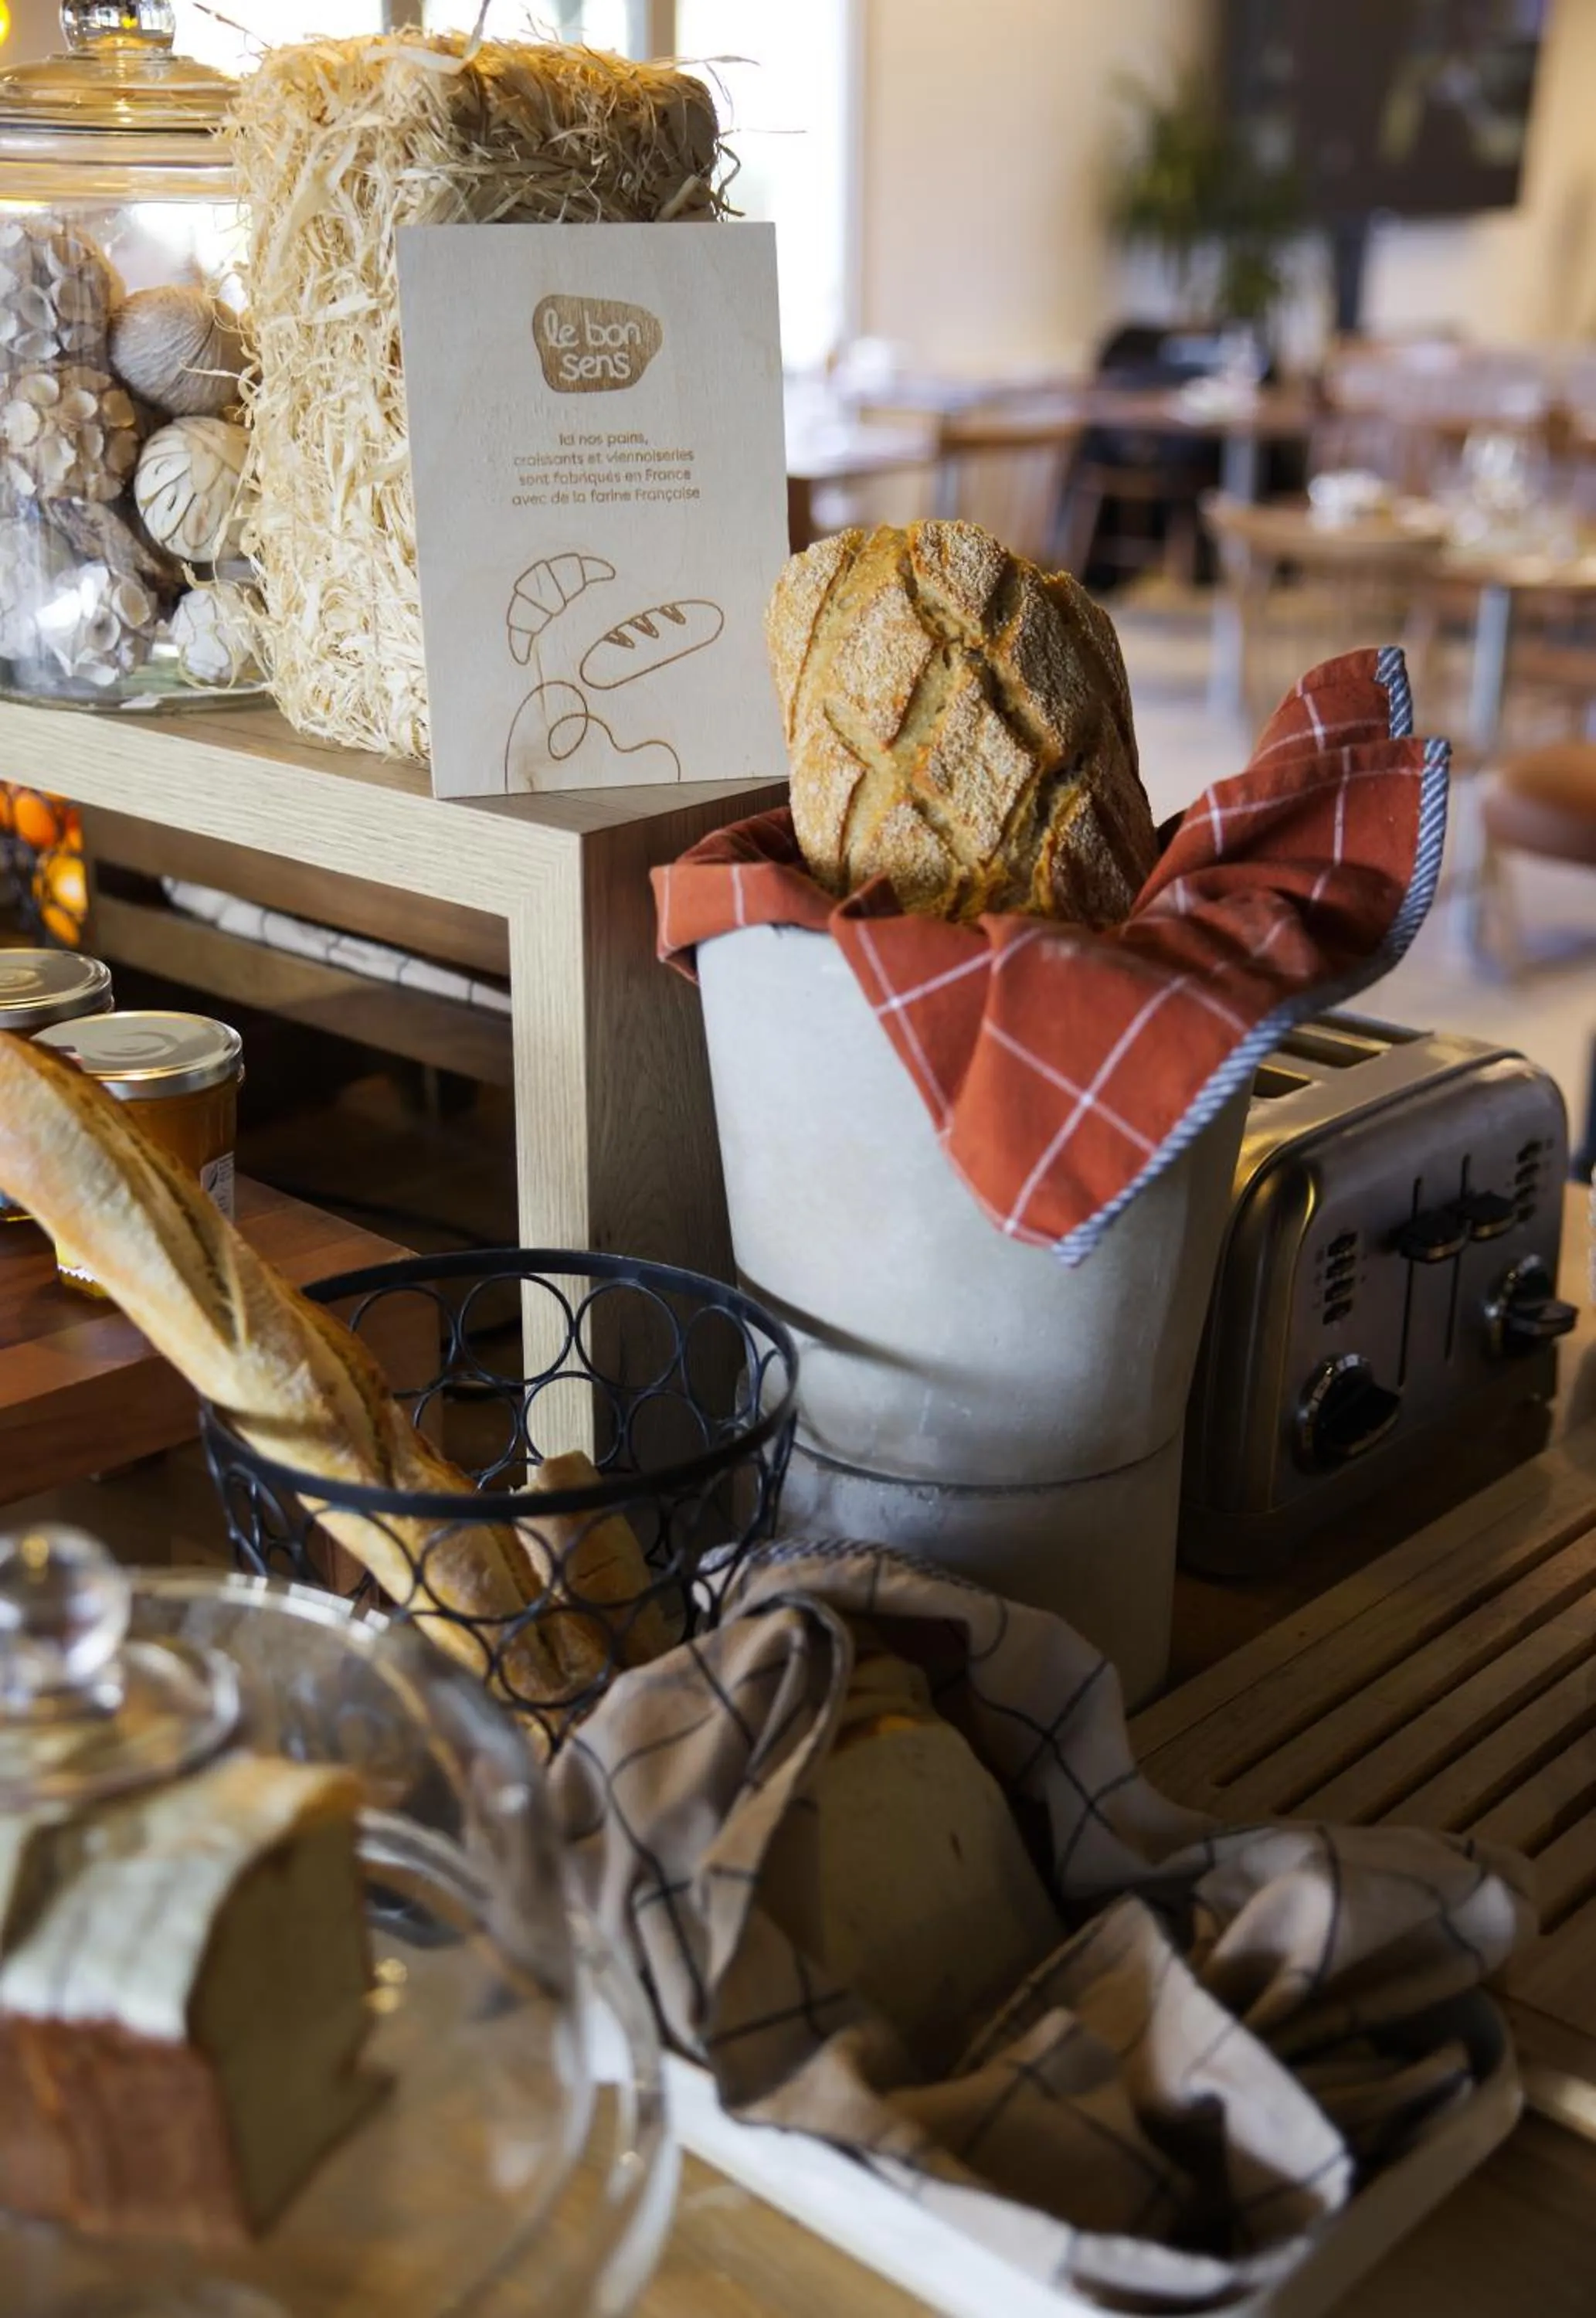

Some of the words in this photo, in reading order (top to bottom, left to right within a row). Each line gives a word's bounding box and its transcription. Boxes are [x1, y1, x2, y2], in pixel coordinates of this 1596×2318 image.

[543, 308, 579, 348] le
[583, 311, 640, 346] bon
[559, 352, 630, 380] sens
[559, 433, 574, 446] Ici
[579, 435, 602, 446] nos
[607, 433, 648, 447] pains,
[514, 453, 583, 466] croissants
[588, 452, 600, 464] et
[606, 448, 694, 463] viennoiseries
[519, 473, 548, 486] sont
[625, 472, 641, 482] en
[645, 468, 691, 481] France
[512, 495, 546, 506] avec
[551, 490, 569, 505] de
[572, 490, 586, 504] la
[591, 488, 631, 503] farine
